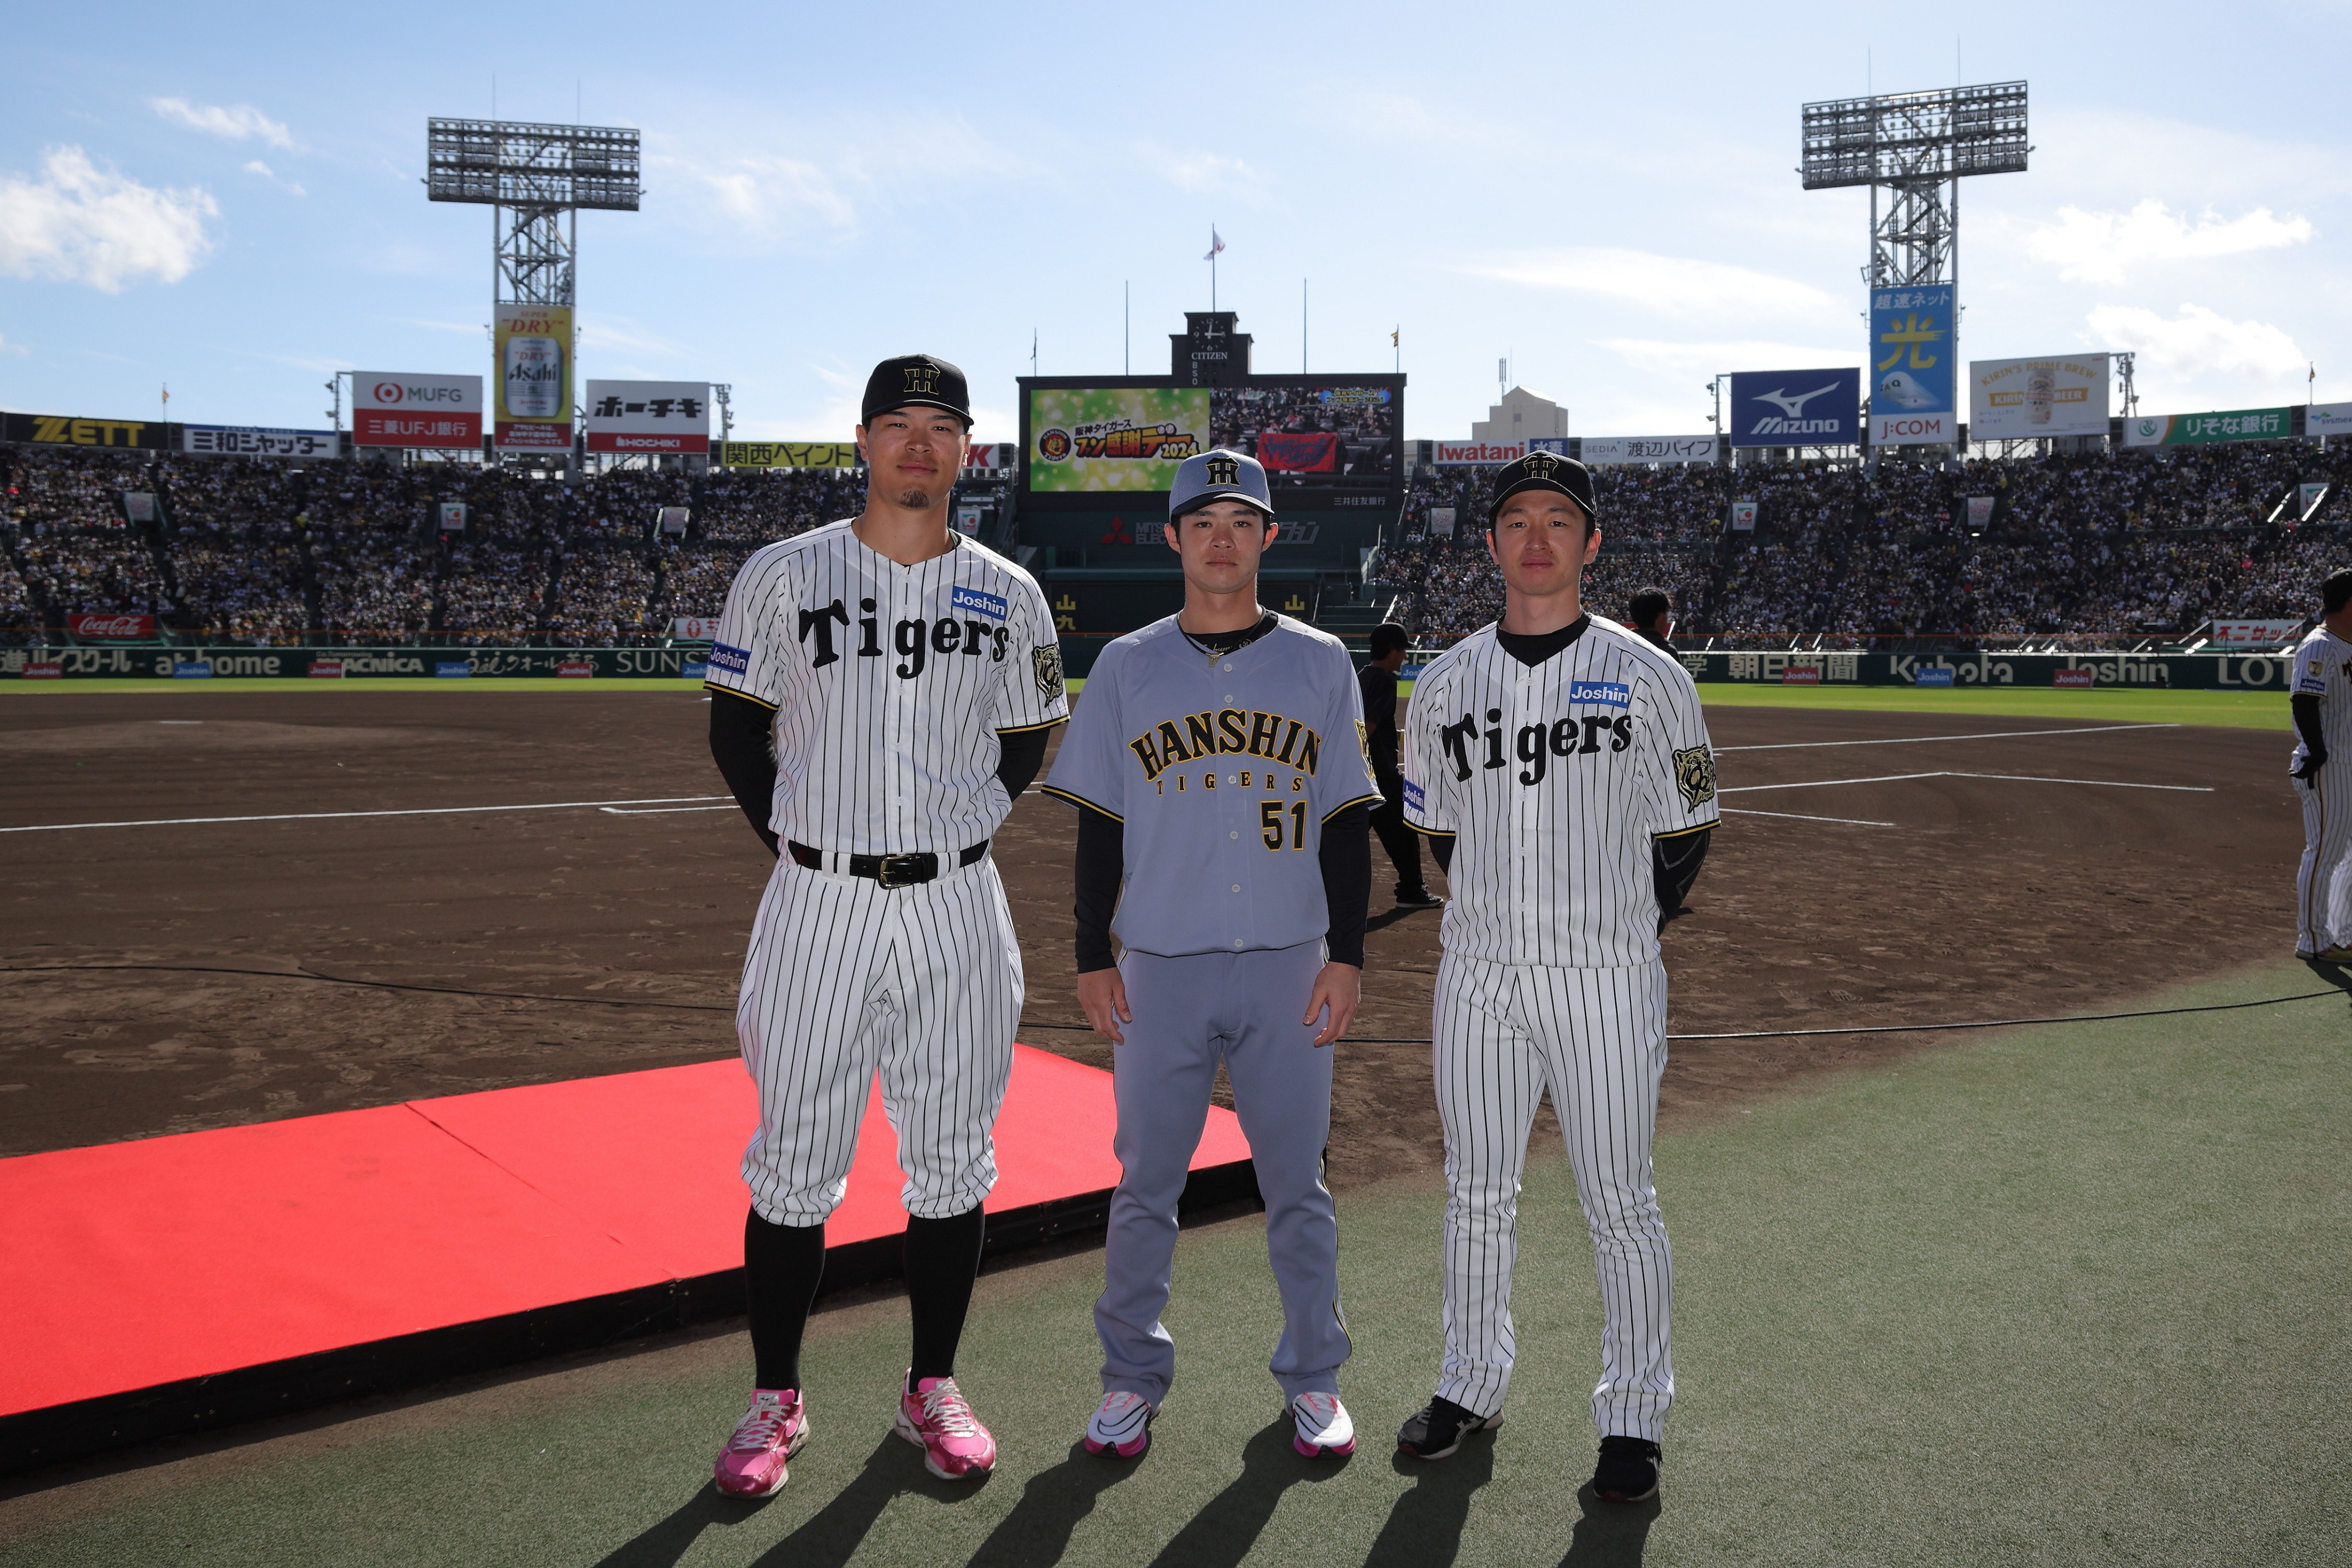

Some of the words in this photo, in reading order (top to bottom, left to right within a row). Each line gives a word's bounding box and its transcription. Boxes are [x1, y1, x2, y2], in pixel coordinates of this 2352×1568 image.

[1874, 291, 1950, 309] 超速ネット
[1877, 313, 1947, 371] 光
[1191, 352, 1228, 360] CITIZEN
[509, 362, 557, 382] Asahi
[1980, 362, 2023, 386] KIRIN'S
[2026, 361, 2061, 372] PRIME
[2064, 362, 2097, 379] BREW
[407, 387, 462, 402] MUFG
[594, 396, 702, 418] ホーチキ
[32, 416, 145, 447] ZETT
[368, 419, 467, 436] 三菱UFJ銀行
[1075, 419, 1132, 436] 阪神タイガース
[1881, 420, 1941, 440] J:COM
[2186, 413, 2280, 436] りそな銀行
[193, 431, 327, 455] 三和シャッター
[624, 439, 681, 448] HOCHIKI
[1161, 442, 1201, 459] 2024
[1437, 441, 1525, 462] Iwatani
[1533, 439, 1564, 456] 水素
[1628, 438, 1716, 457] 渡辺パイプ
[725, 444, 852, 466] 関西ペイント
[1333, 497, 1386, 506] 三井住友銀行
[953, 591, 1006, 615] Joshin
[798, 597, 1009, 679] Tigers
[616, 651, 710, 673] SUNS
[710, 647, 746, 670] Joshin
[1728, 654, 1858, 681] 朝日新聞
[176, 666, 208, 675] Joshin
[437, 666, 469, 674] Joshin
[559, 666, 590, 675] Joshin
[1784, 671, 1817, 681] Joshin
[1918, 672, 1950, 682] Joshin
[2056, 674, 2090, 684] Joshin
[1570, 684, 1630, 703] Joshin
[2301, 679, 2324, 690] Joshin
[1128, 708, 1322, 782] HANSHIN
[1441, 708, 1632, 786] Tigers
[1156, 770, 1304, 797] TIGERS
[1403, 785, 1424, 807] Joshin
[1259, 799, 1308, 852] 51
